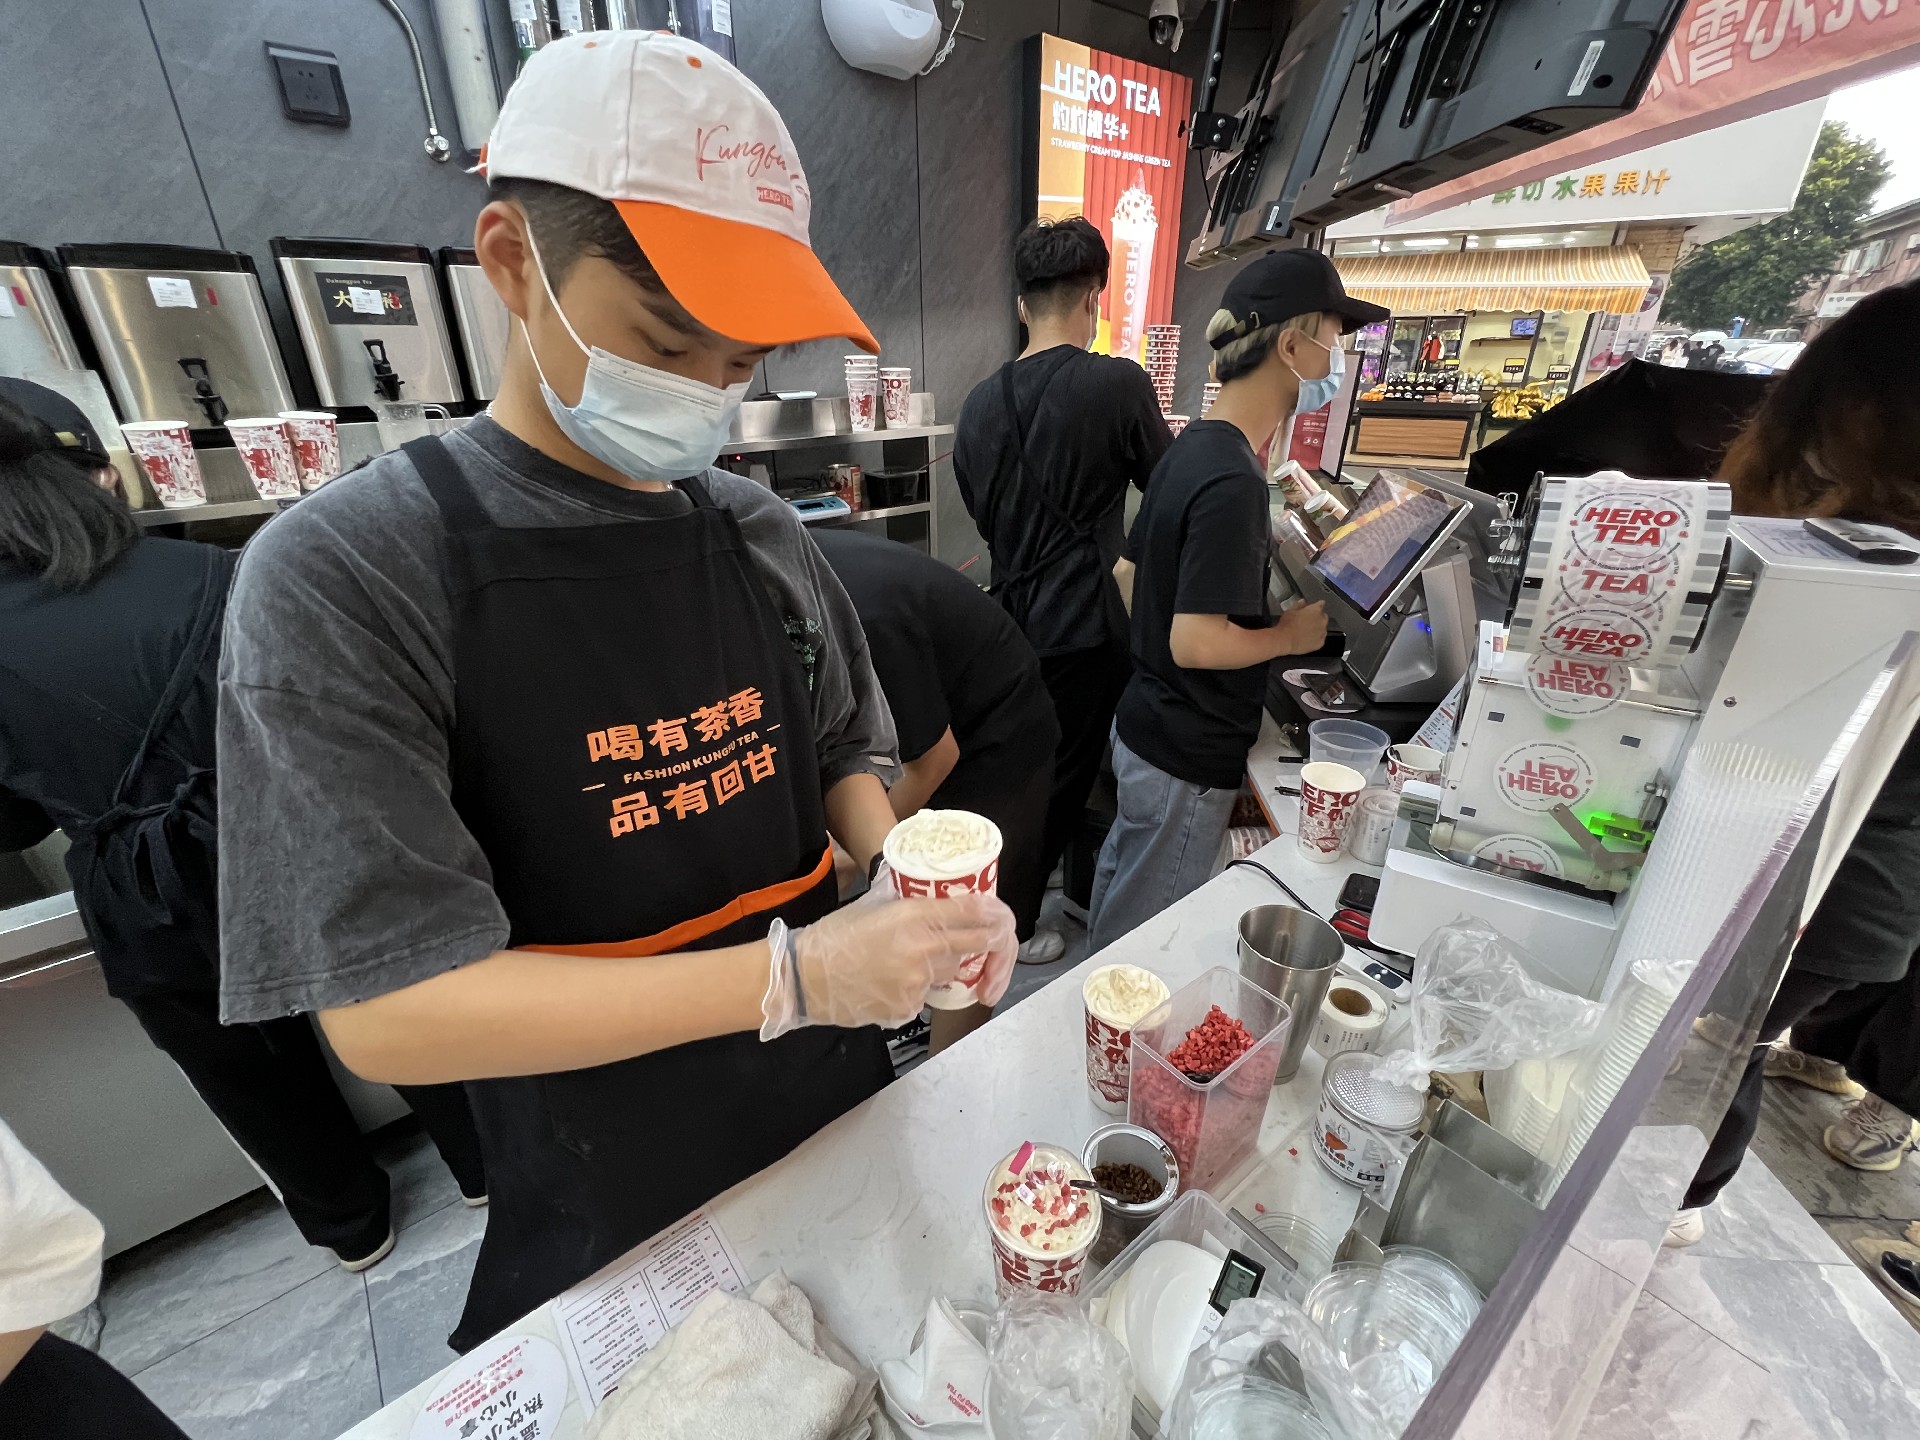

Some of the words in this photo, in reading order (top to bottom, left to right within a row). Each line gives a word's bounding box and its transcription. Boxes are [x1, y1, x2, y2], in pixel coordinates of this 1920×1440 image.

[1054, 60, 1117, 106] HERO
[1122, 79, 1161, 117] TEA
[695, 124, 787, 182] Kungfu
[1050, 137, 1090, 152] STRAWBERRY
[1090, 145, 1111, 157] CREAM
[1110, 149, 1122, 159] TOP
[1121, 151, 1145, 164] JASMINE
[1144, 155, 1161, 167] GREEN
[1160, 158, 1172, 168] TEA
[1552, 173, 1607, 200] 水果
[1613, 167, 1671, 196] 果汁
[1123, 239, 1140, 306] HERO
[1120, 312, 1134, 353] TEA
[1583, 507, 1680, 527] HERO
[1594, 524, 1660, 547] TEA
[1582, 569, 1649, 596] TEA
[1552, 626, 1643, 648] HERO
[1562, 640, 1624, 657] TEA
[586, 686, 764, 763] 喝有茶香
[623, 760, 691, 784] FASHION
[737, 731, 760, 748] TEA
[609, 743, 778, 839] 品有回甘
[484, 1392, 545, 1440] 热饮小
